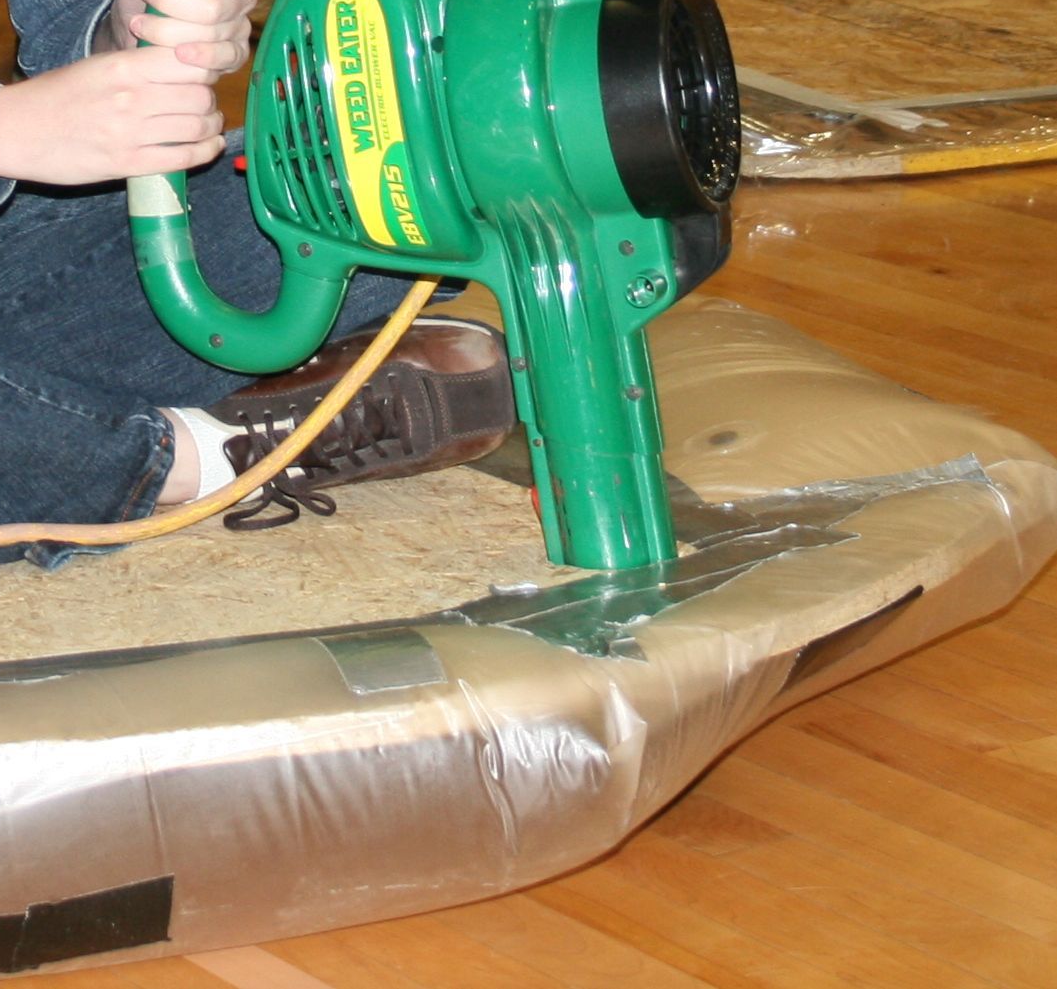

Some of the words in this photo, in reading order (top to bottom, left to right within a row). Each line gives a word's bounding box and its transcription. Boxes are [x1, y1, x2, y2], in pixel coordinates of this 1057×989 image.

[336, 1, 363, 75] EATER
[367, 20, 377, 46] VAC
[371, 47, 384, 89] BLOWER
[345, 81, 375, 153] WEED
[378, 89, 391, 140] ELECTRIC
[383, 163, 427, 246] EBV215
